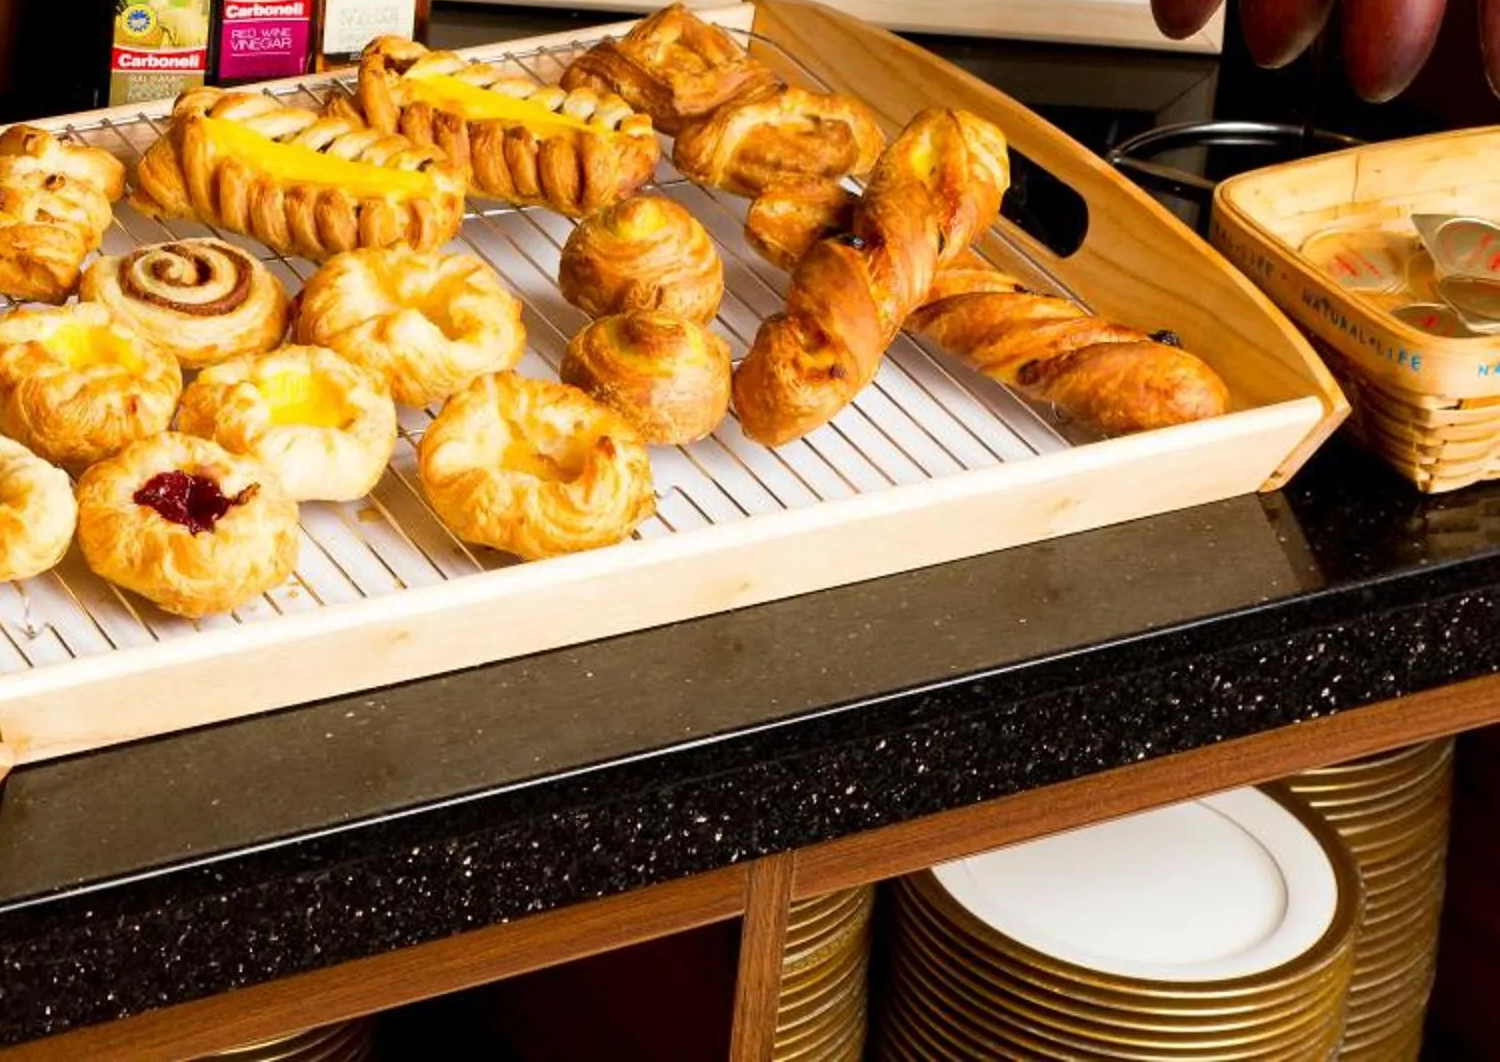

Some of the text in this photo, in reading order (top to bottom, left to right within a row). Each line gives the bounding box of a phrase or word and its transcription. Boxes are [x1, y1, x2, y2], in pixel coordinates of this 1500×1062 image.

[225, 2, 304, 19] Carbonell
[231, 27, 293, 39] RED WINE
[230, 37, 293, 51] VINEGAR
[118, 53, 200, 68] Carbonell
